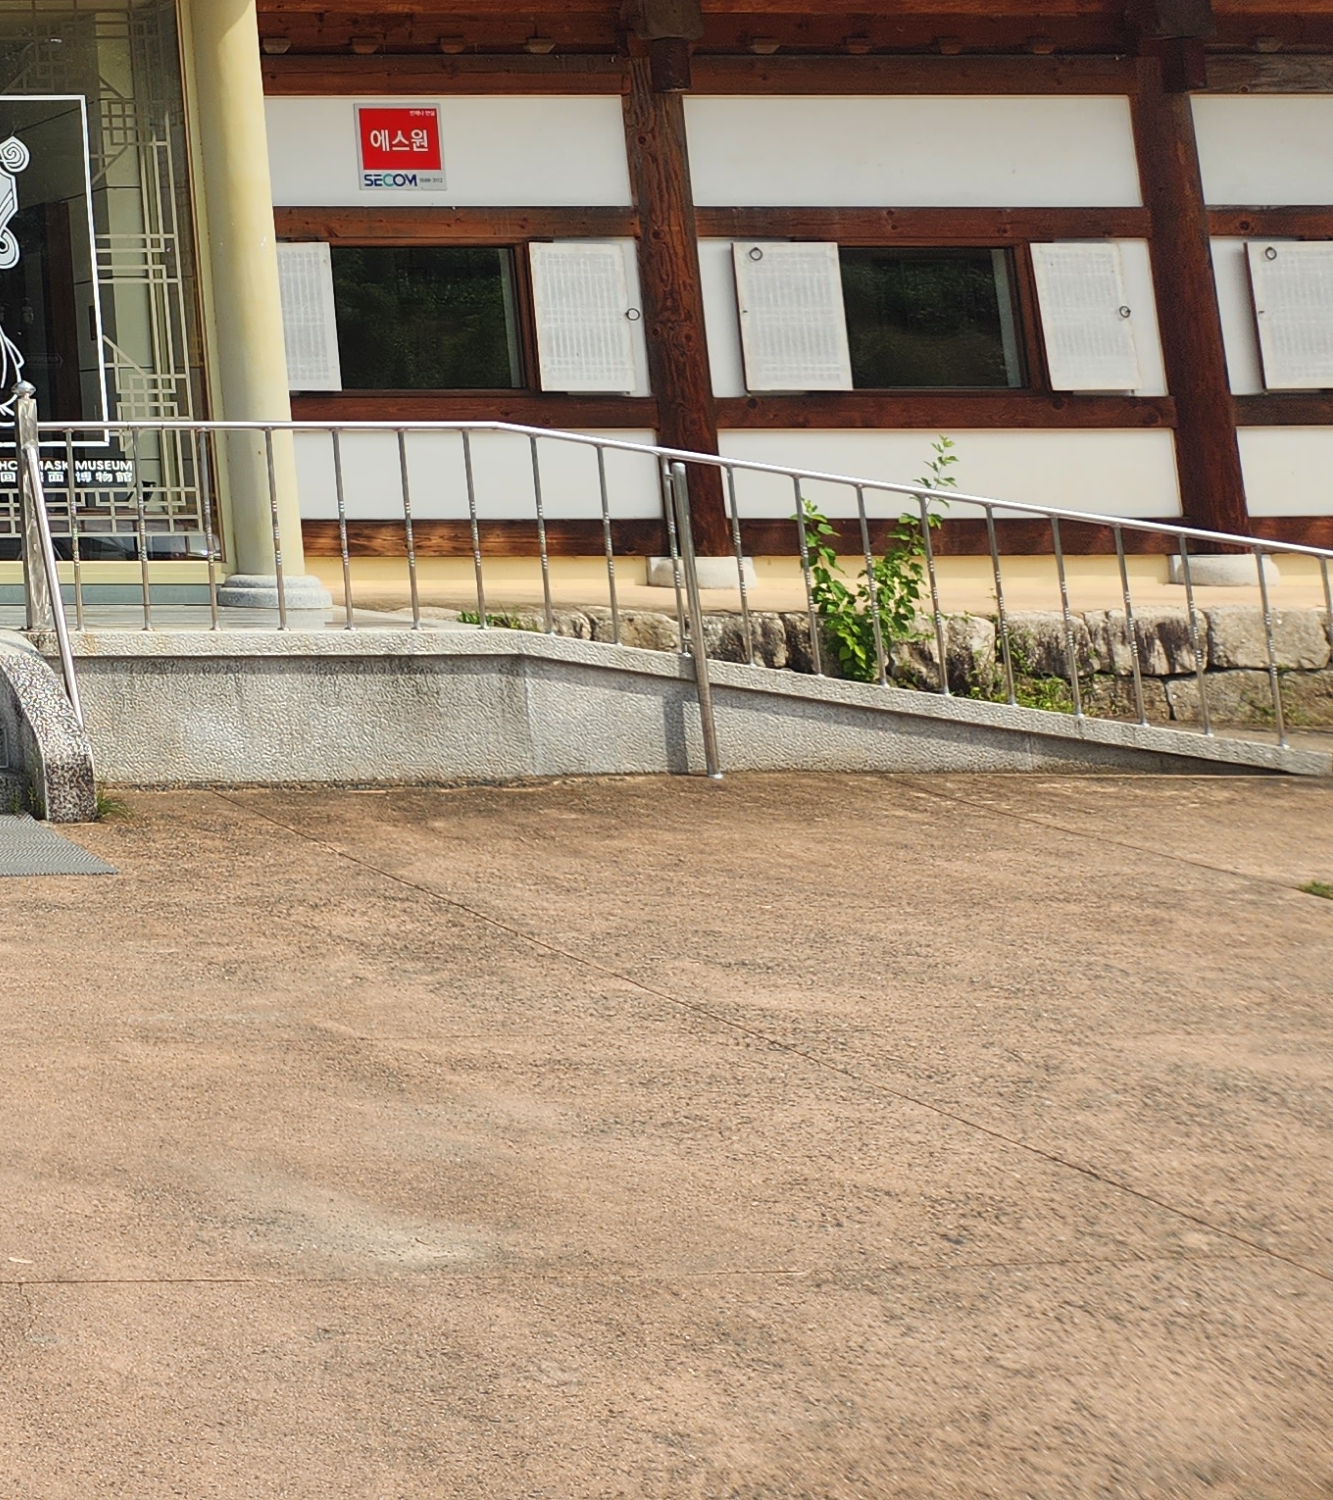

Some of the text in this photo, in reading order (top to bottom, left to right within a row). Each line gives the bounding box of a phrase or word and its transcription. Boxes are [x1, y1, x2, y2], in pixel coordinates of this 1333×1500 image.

[370, 129, 429, 152] 에스원
[364, 173, 418, 187] SECOM
[75, 460, 133, 471] MUSEUM
